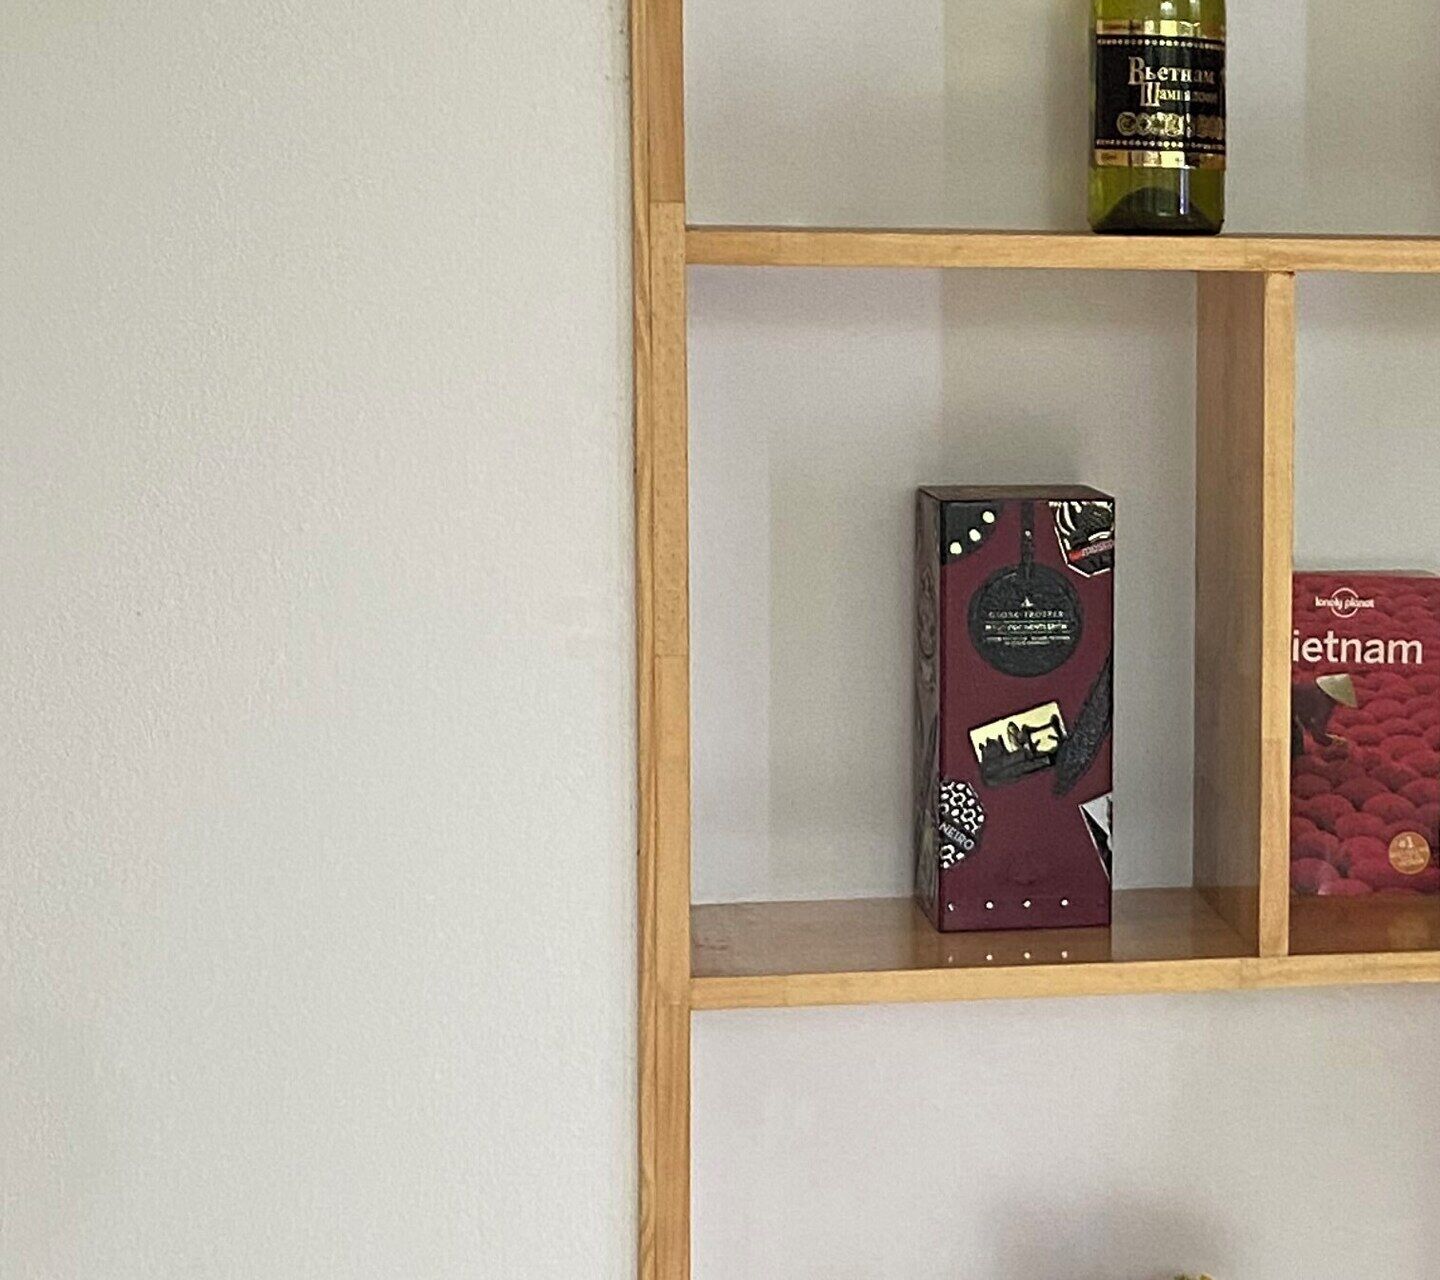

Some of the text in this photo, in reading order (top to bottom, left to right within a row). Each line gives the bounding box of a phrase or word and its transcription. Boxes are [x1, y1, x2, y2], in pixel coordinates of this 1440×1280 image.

[1127, 56, 1216, 86] Вьетнам
[1314, 595, 1375, 610] lonely planet
[1292, 629, 1424, 665] ietnam
